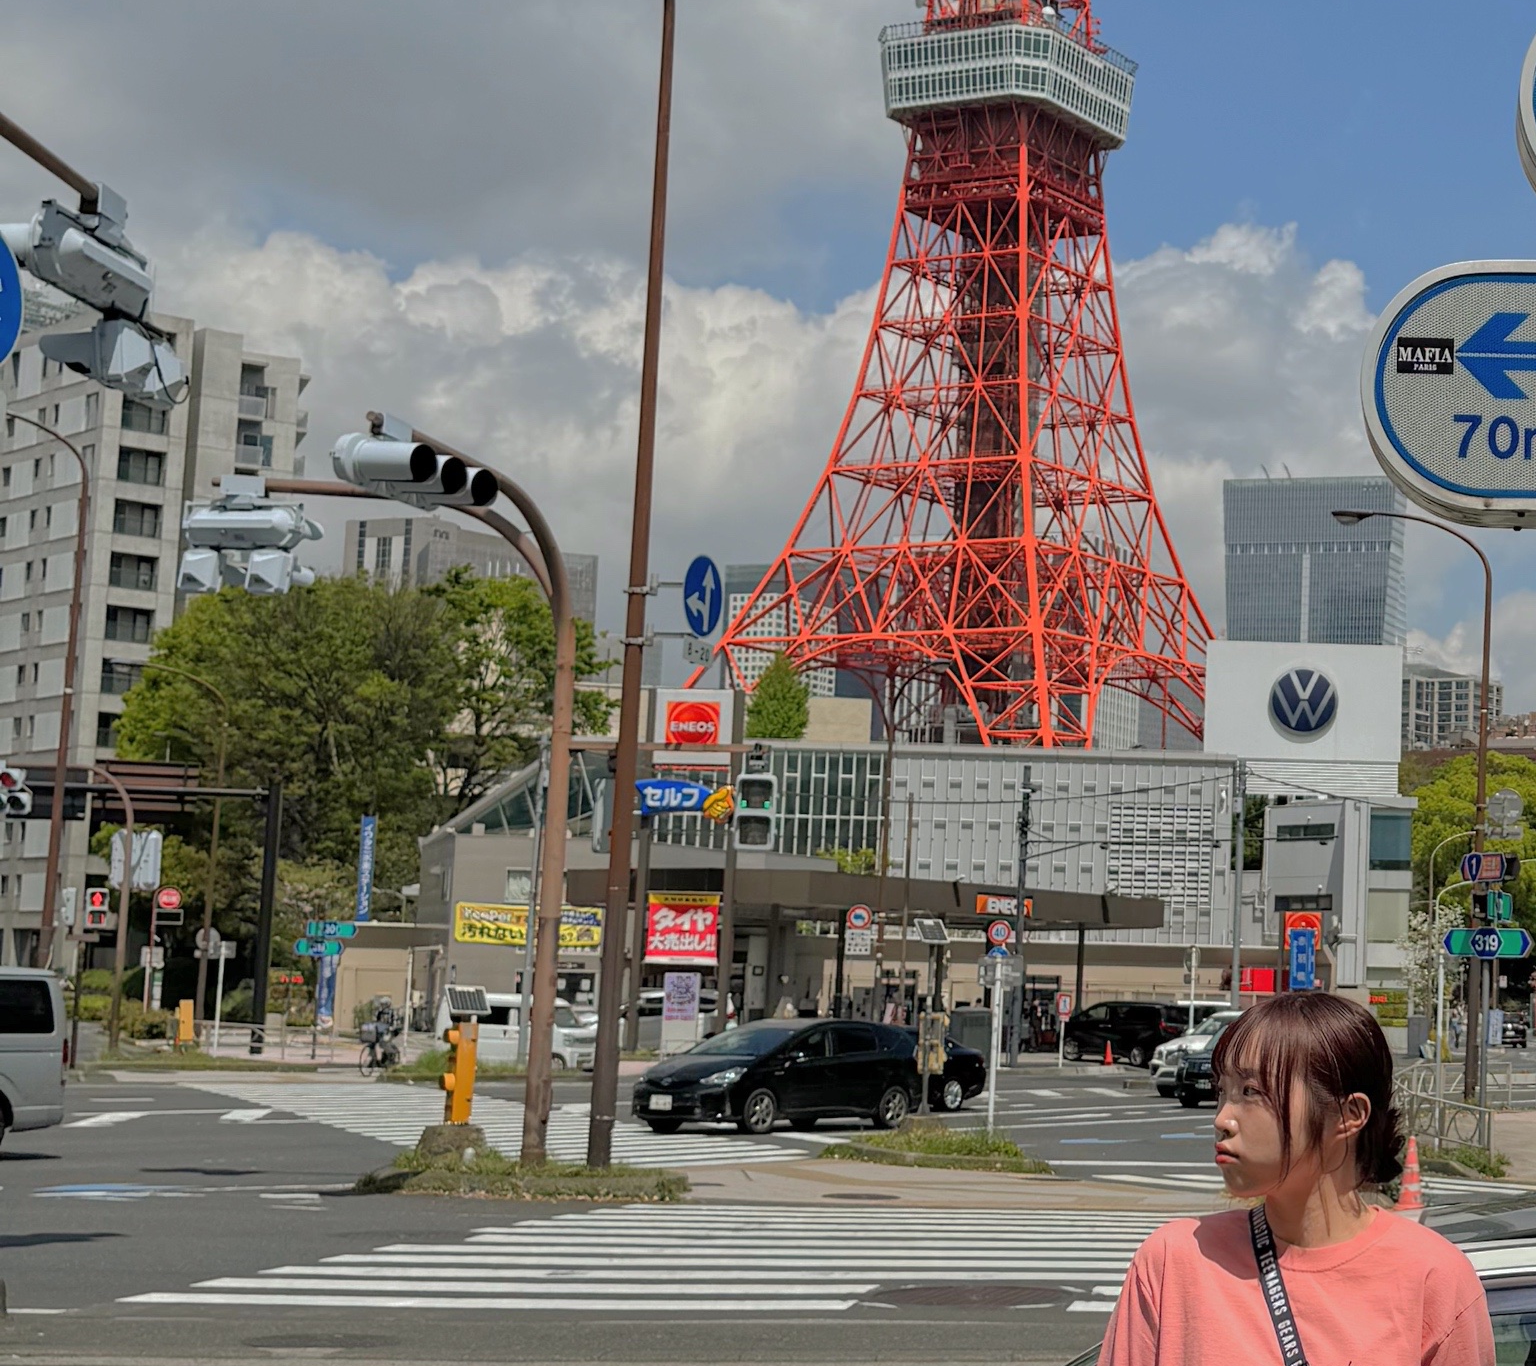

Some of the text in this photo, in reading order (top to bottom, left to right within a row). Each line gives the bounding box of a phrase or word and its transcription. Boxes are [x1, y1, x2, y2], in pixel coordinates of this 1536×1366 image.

[1398, 346, 1453, 363] MAFIA
[1413, 363, 1437, 371] PARIS
[669, 721, 715, 733] ENEOS
[643, 786, 700, 808] セルフ
[1470, 858, 1477, 875] 1
[653, 907, 715, 932] タイヤ
[994, 926, 1006, 937] 40
[1474, 934, 1498, 952] 319
[1259, 1249, 1288, 1316] TEENAGERS
[1277, 1319, 1299, 1358] GEARS
